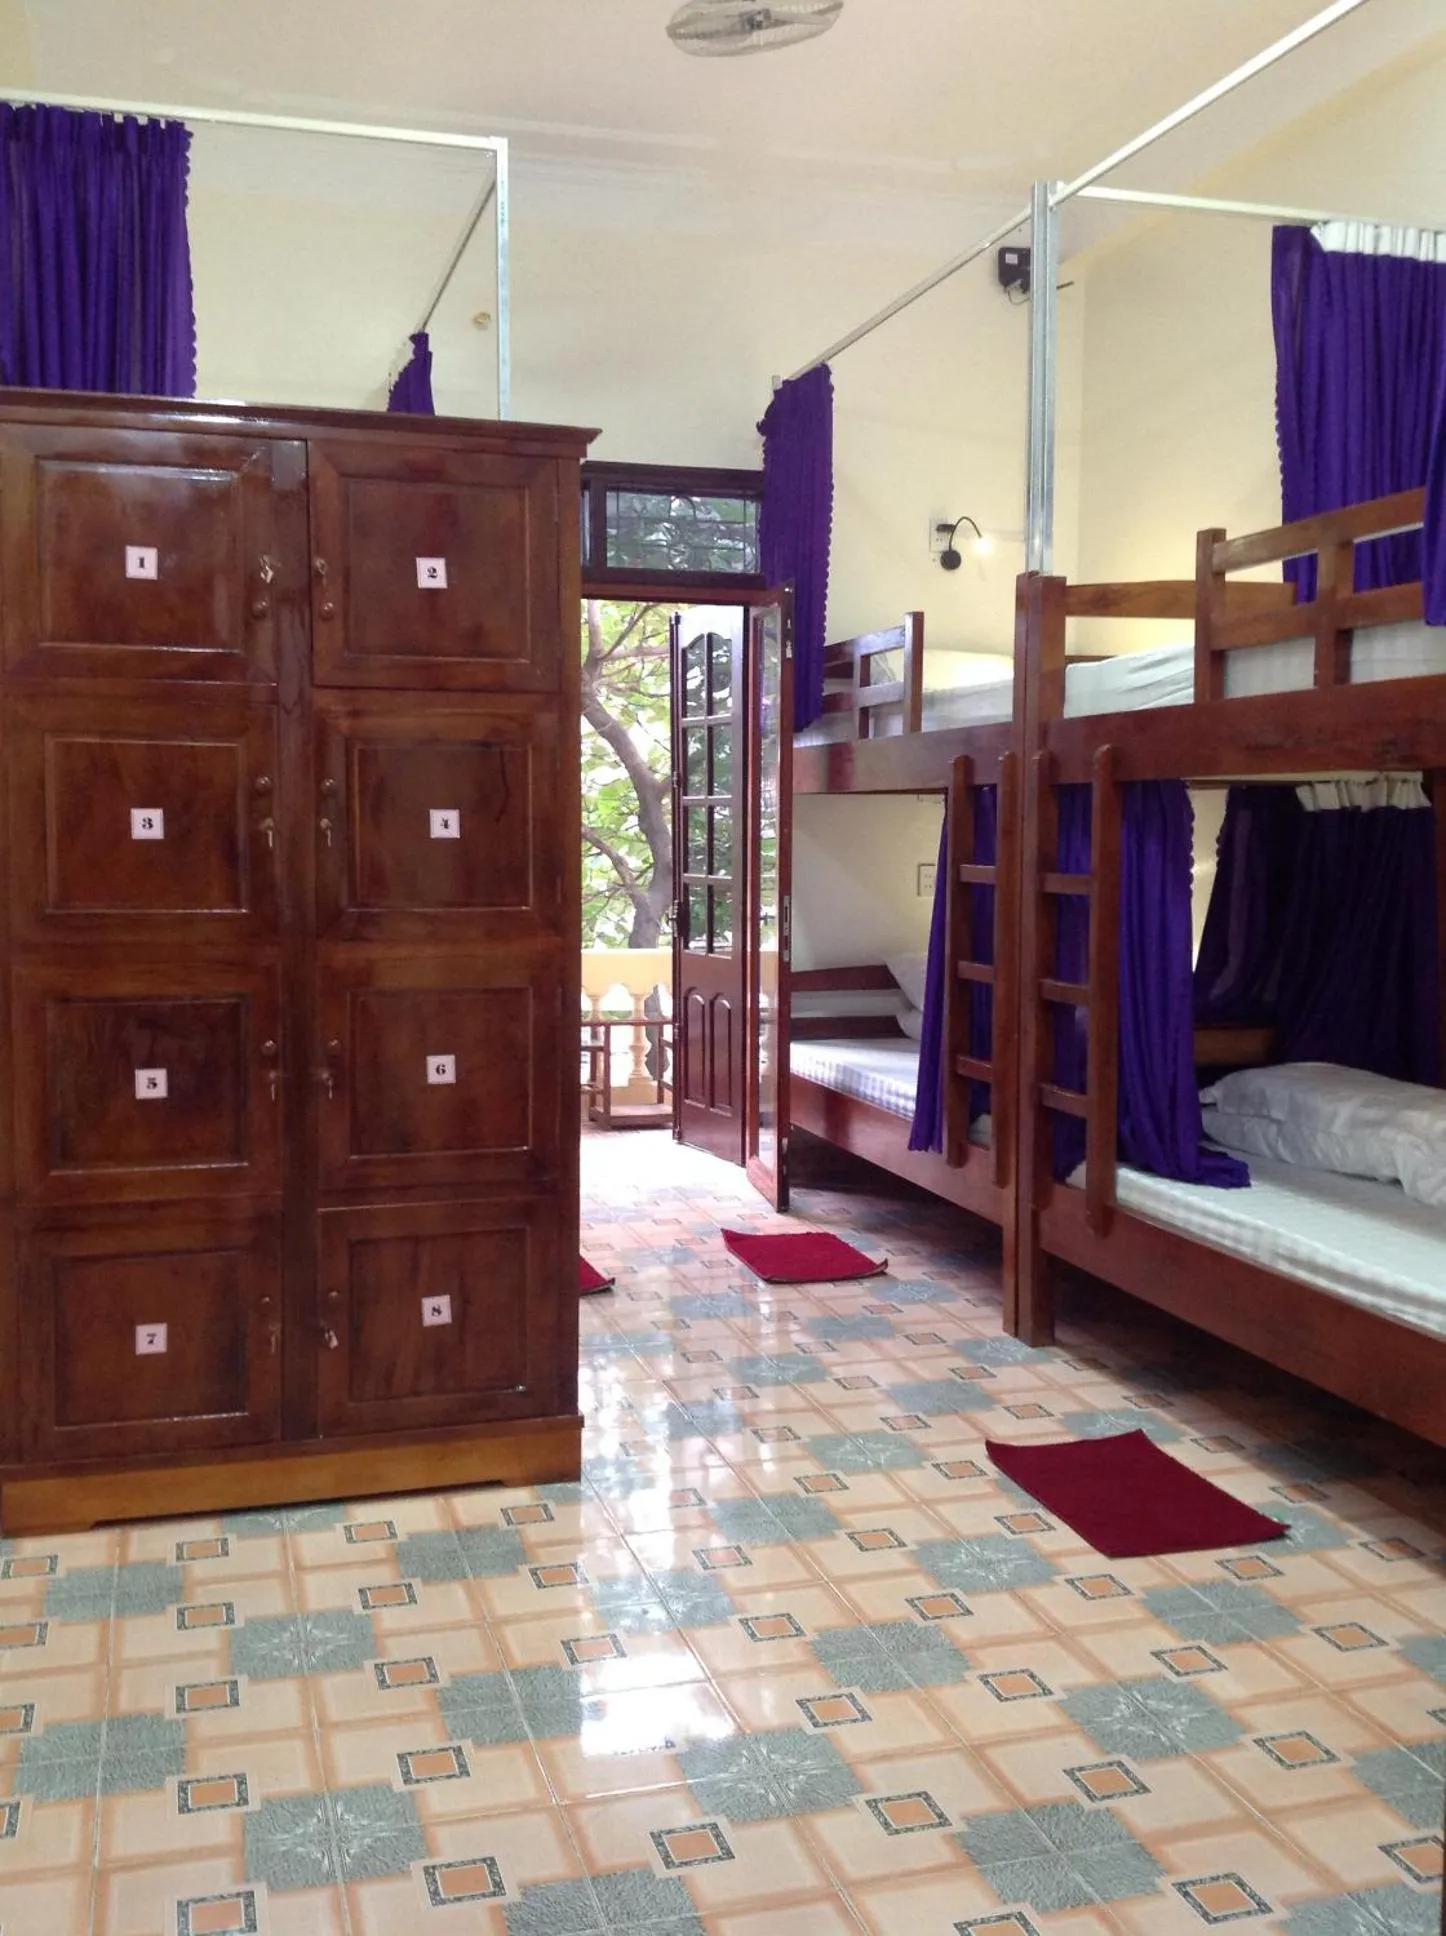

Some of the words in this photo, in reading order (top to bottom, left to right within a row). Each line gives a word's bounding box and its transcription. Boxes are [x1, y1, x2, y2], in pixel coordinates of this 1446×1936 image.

[138, 557, 145, 569] 1
[427, 567, 438, 579] 2
[142, 817, 154, 830] 3
[440, 818, 449, 830] 4
[435, 1063, 446, 1075] 6
[146, 1077, 158, 1089] 5
[431, 1305, 442, 1317] 8
[146, 1333, 157, 1345] 7
